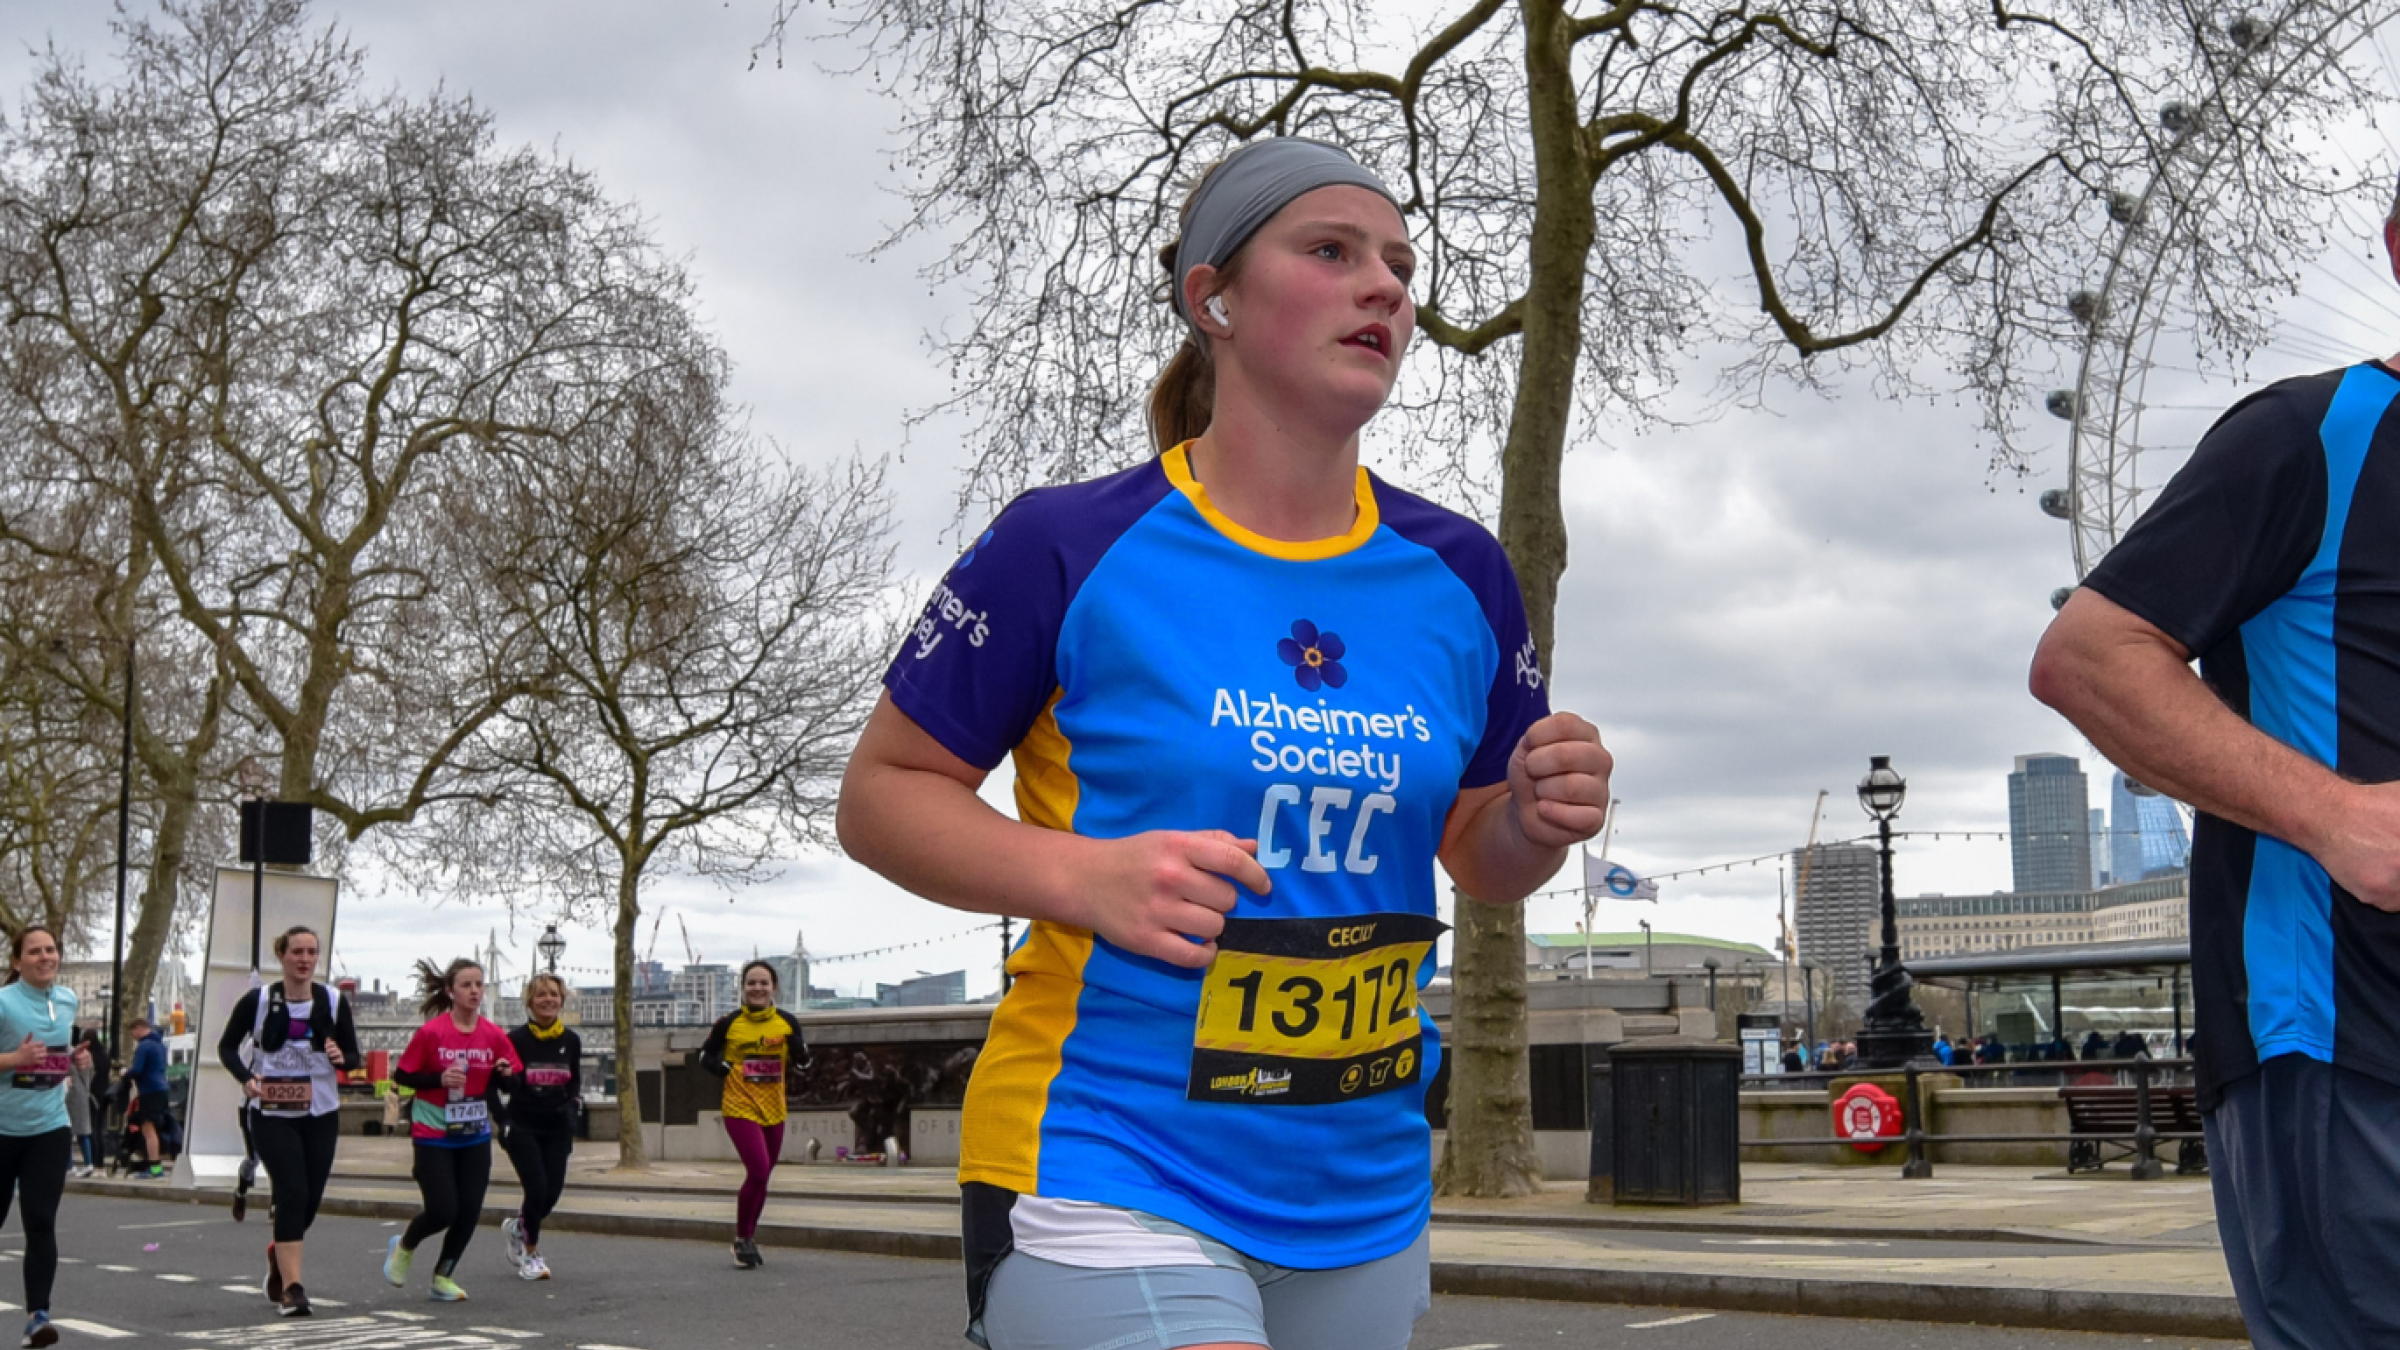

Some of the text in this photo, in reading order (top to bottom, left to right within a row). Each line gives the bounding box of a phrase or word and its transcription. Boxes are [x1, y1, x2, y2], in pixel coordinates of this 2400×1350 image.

[1210, 687, 1431, 742] Alzheimer's
[1250, 730, 1400, 793] Society
[1256, 783, 1397, 874] CEC
[1228, 957, 1410, 1040] 13172
[791, 1119, 847, 1135] BATTLE
[917, 1119, 939, 1134] OF
